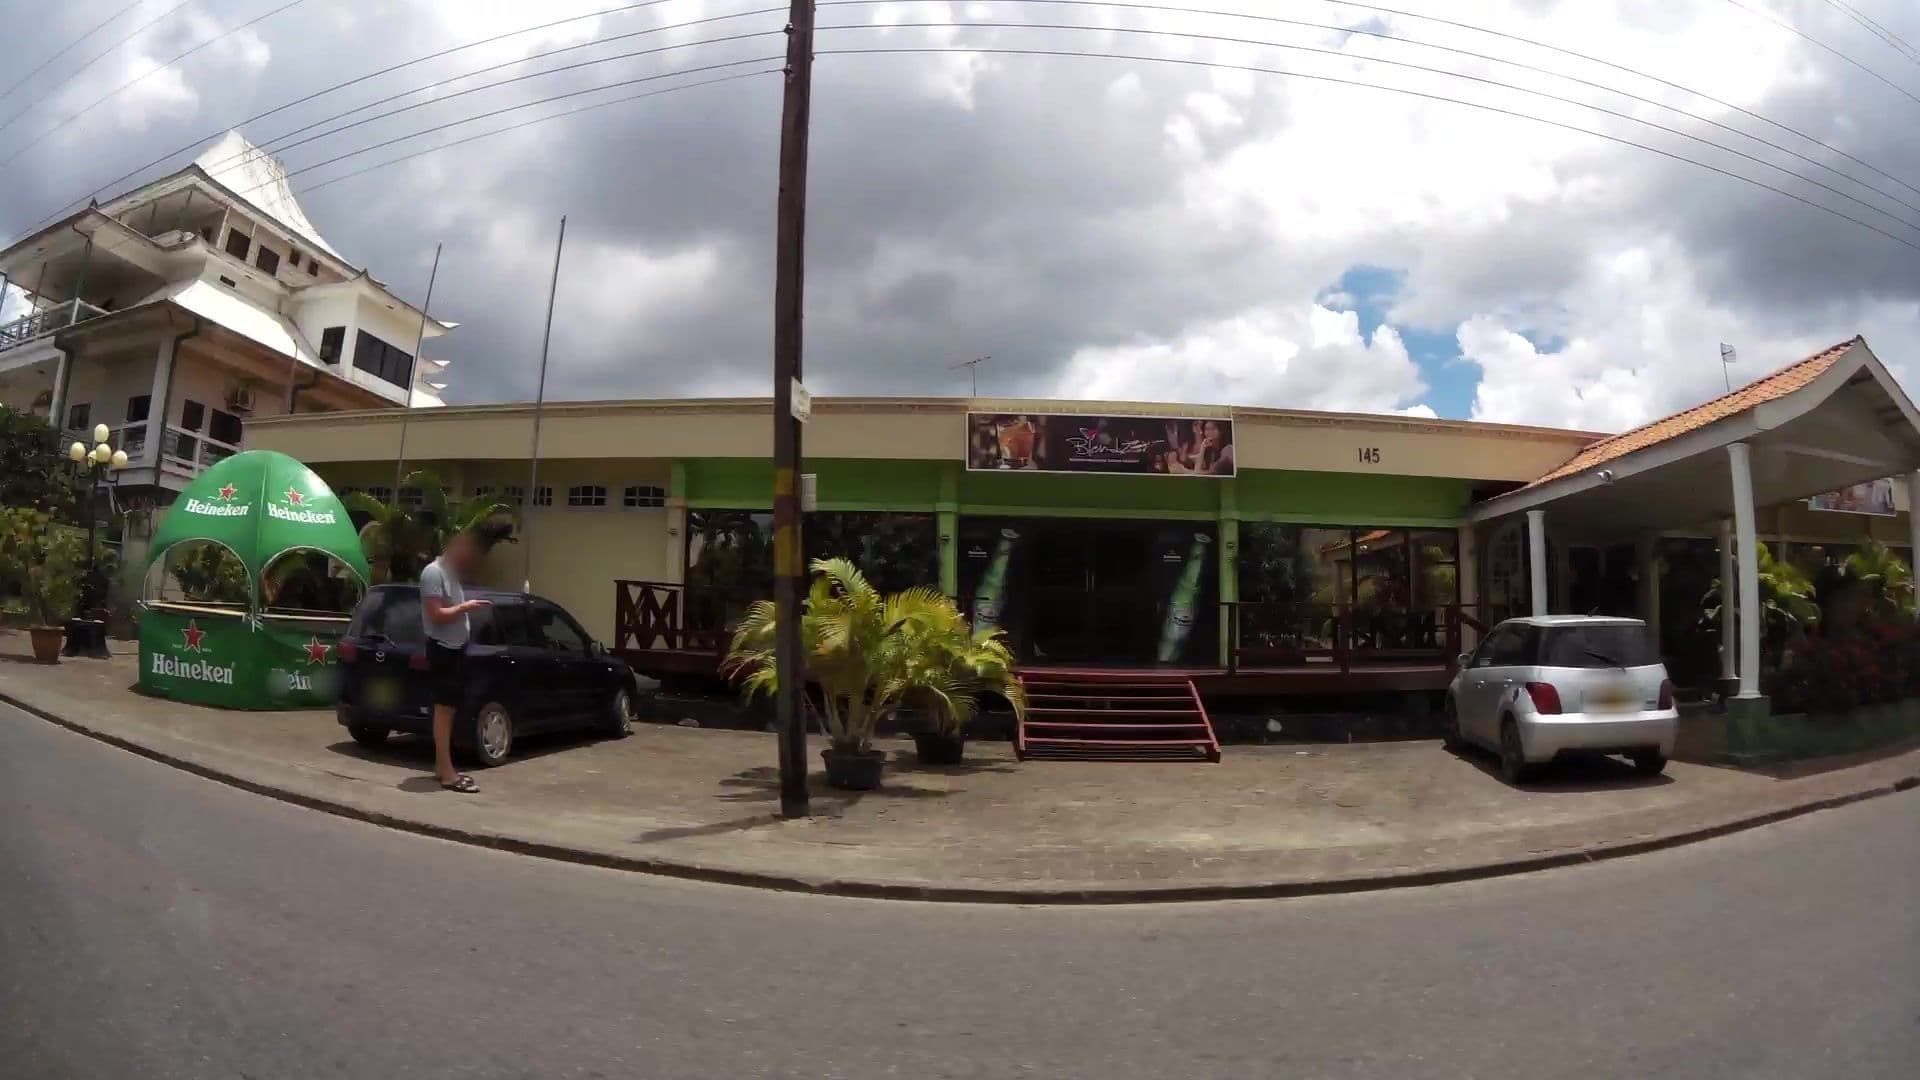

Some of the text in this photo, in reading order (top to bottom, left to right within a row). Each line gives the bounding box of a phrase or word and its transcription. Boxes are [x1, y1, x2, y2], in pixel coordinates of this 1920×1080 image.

[1358, 447, 1380, 464] 145
[184, 498, 249, 517] Heineken
[267, 502, 336, 525] Heineken
[151, 652, 234, 685] Heineken
